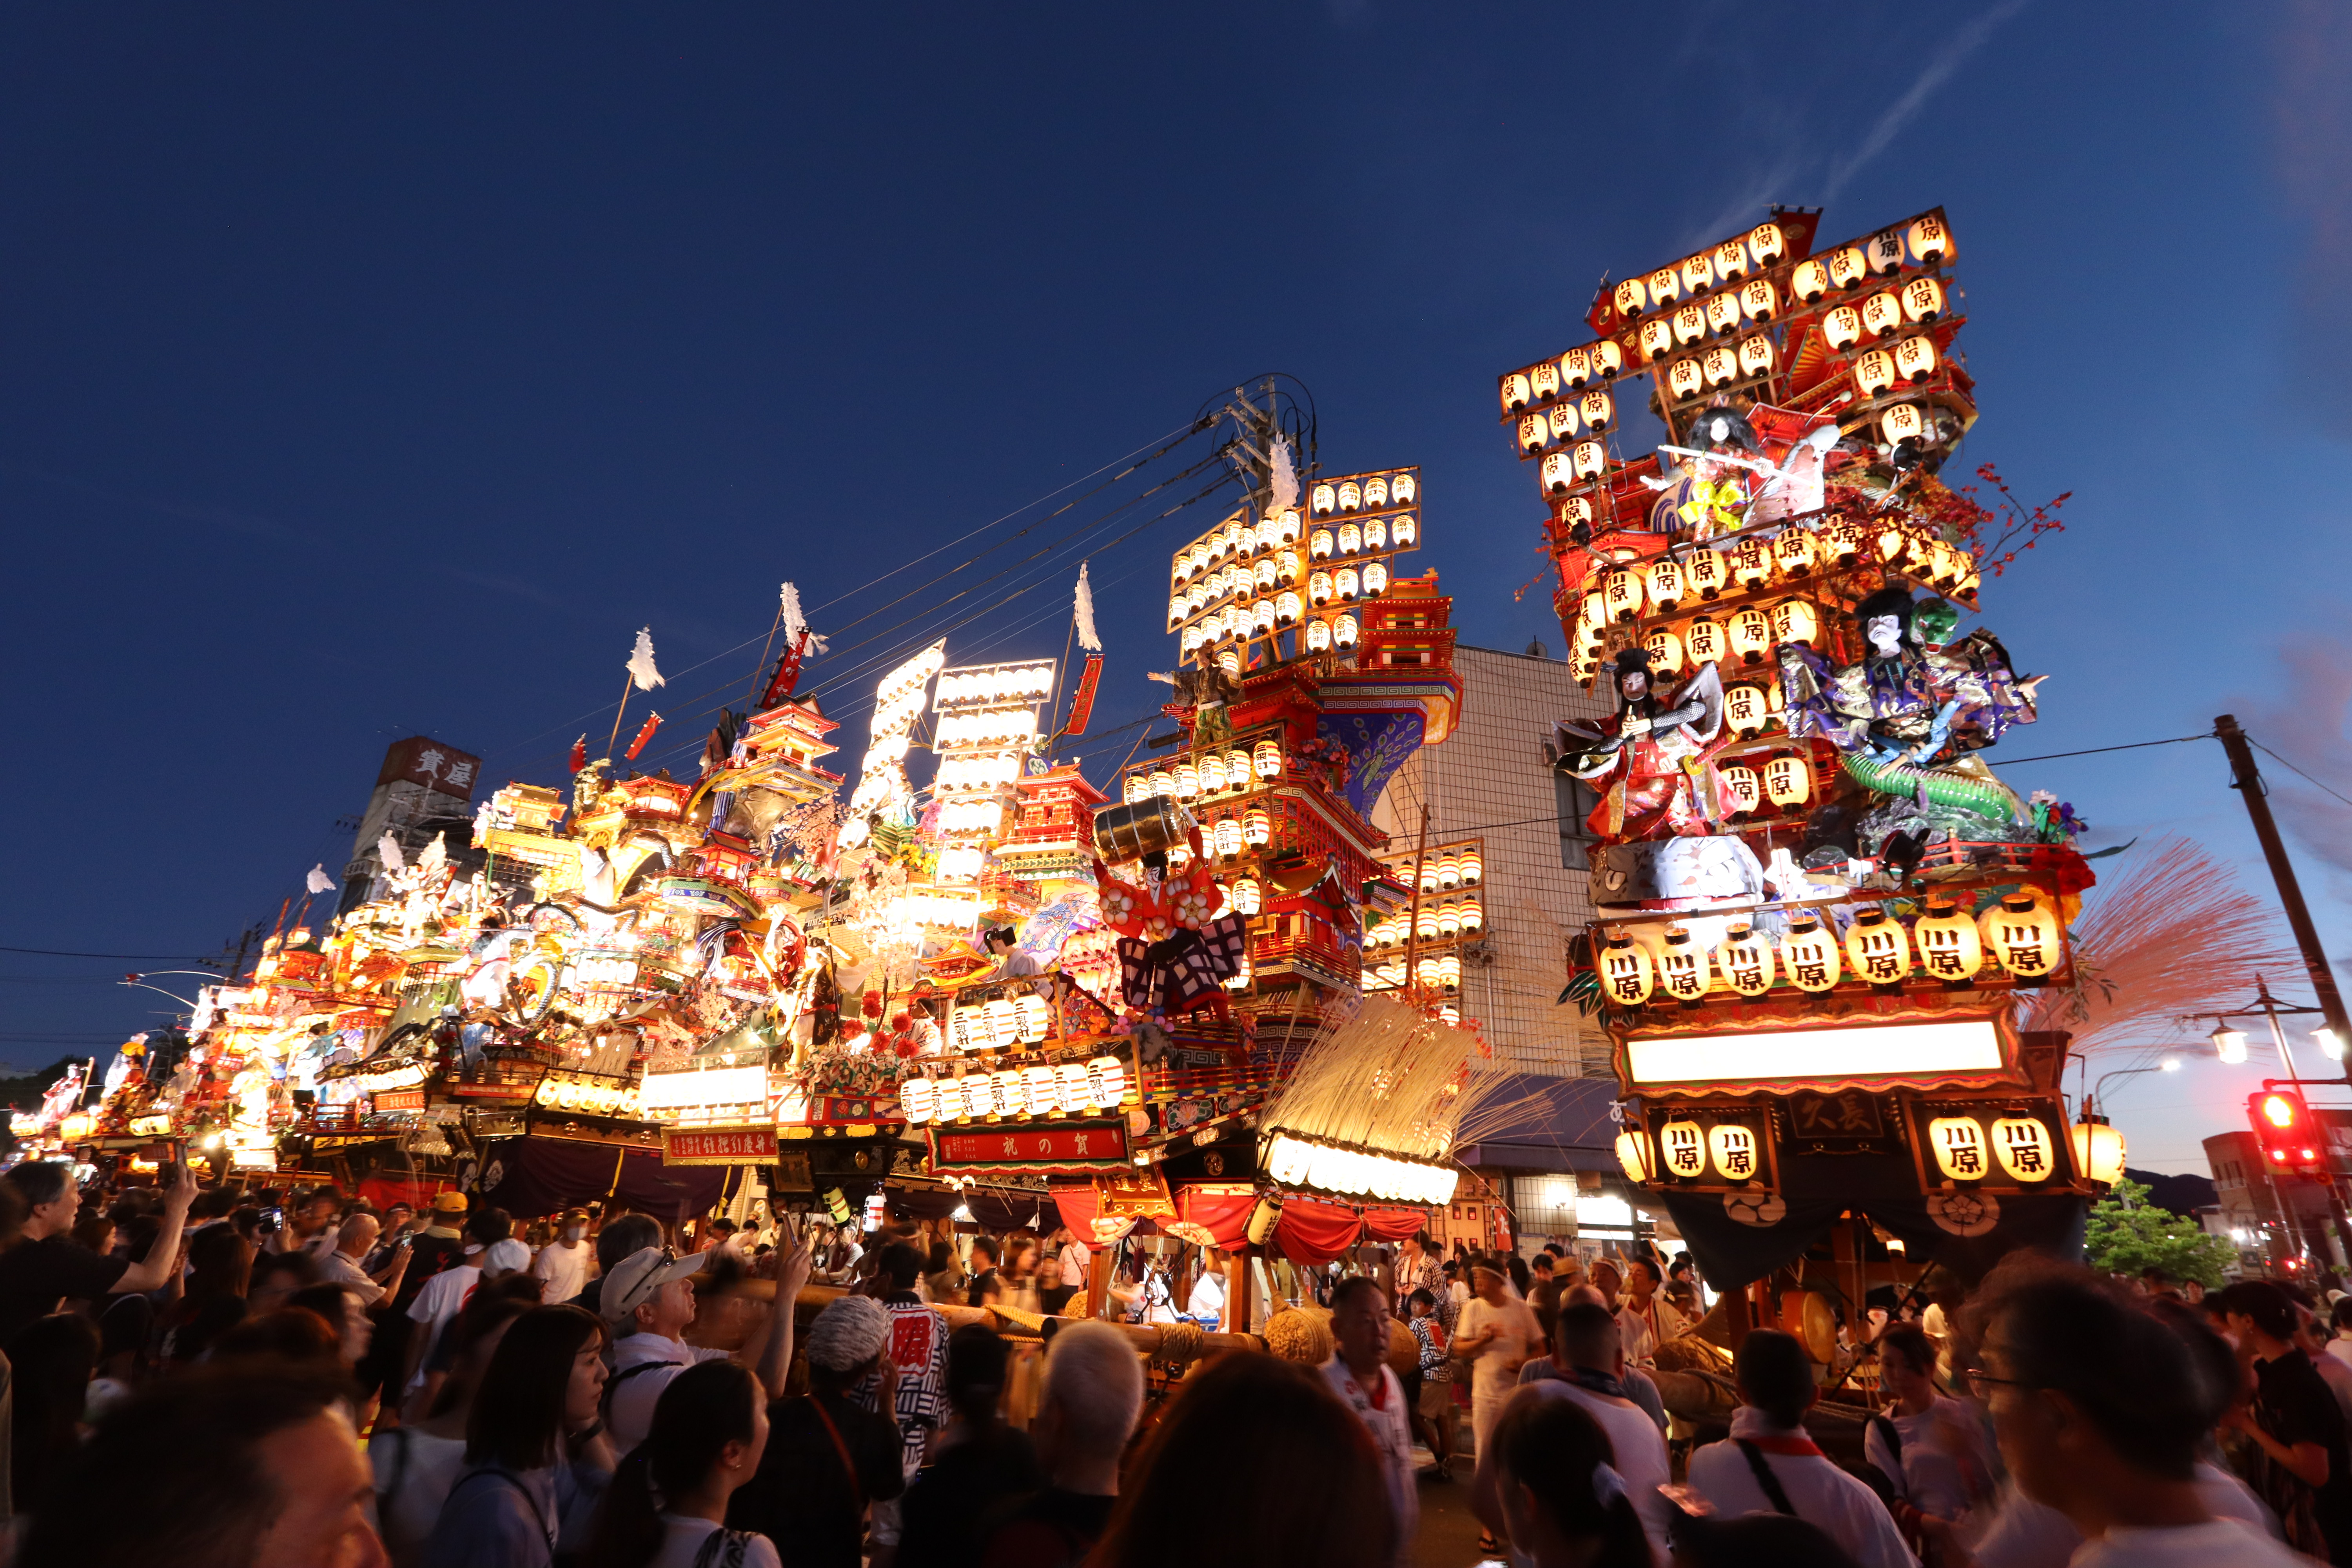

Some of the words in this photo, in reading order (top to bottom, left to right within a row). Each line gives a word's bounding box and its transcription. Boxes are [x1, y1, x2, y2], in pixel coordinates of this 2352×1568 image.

[1755, 225, 1774, 249] 川原
[1920, 218, 1940, 240] 川原
[1722, 242, 1741, 263] 川原
[1879, 232, 1900, 257] 川原
[1690, 256, 1708, 275] 川原
[1832, 248, 1853, 276] 川原
[1618, 281, 1634, 306] 川原
[1654, 269, 1672, 291] 川原
[1748, 281, 1768, 304] 川原
[1910, 280, 1934, 308] 川原
[1681, 307, 1700, 328] 川原
[1710, 295, 1727, 322] 川原
[1836, 309, 1856, 331] 川原
[1865, 296, 1886, 323] 川原
[1643, 321, 1659, 345] 川原
[1569, 350, 1584, 370] 川原
[1592, 343, 1606, 368] 川原
[1747, 337, 1767, 360] 川原
[1901, 339, 1921, 365] 川原
[1537, 364, 1553, 383] 川原
[1674, 361, 1692, 383] 川原
[1706, 350, 1725, 375] 川原
[1862, 351, 1884, 381] 川原
[1504, 376, 1516, 399] 川原
[1553, 404, 1568, 426] 川原
[1587, 392, 1603, 412] 川原
[1522, 415, 1536, 439] 川原
[1892, 406, 1914, 428] 川原
[1545, 455, 1559, 476] 川原
[1577, 444, 1592, 466] 川原
[1566, 499, 1581, 519] 川原
[1780, 528, 1805, 558] 川原
[1655, 564, 1676, 591] 川原
[1691, 550, 1715, 581] 川原
[1609, 574, 1628, 602] 川原
[1743, 612, 1765, 641] 川原
[1777, 606, 1793, 636] 川原
[1647, 635, 1667, 663] 川原
[1691, 624, 1713, 654] 川原
[1730, 690, 1753, 720] 川原
[1200, 759, 1211, 782] 三隈町
[1225, 753, 1235, 777] 三隈町
[1255, 745, 1267, 769] 三隈町
[1125, 779, 1135, 802] 三隈町
[1172, 768, 1183, 792] 三隈町
[1730, 769, 1754, 800] 川原
[1769, 762, 1793, 795] 川原
[1216, 824, 1229, 849] 三隈町
[1243, 813, 1256, 838] 三隈町
[1234, 883, 1246, 910] 三隈町
[1860, 932, 1900, 978] 川原
[1924, 929, 1964, 975] 川原
[2003, 926, 2045, 971] 川原
[1610, 955, 1644, 1000] 川原
[1665, 954, 1700, 995] 川原
[1728, 947, 1766, 991] 川原
[1791, 944, 1829, 986] 川原
[954, 1012, 969, 1045] 三隈町
[983, 1008, 996, 1041] 三隈町
[1014, 1003, 1029, 1037] 三隈町
[541, 1086, 556, 1102] 大和
[960, 1082, 973, 1112] 三隈町
[990, 1077, 1005, 1110] 三隈町
[1020, 1074, 1033, 1109] 三隈町
[1054, 1072, 1069, 1107] 三隈町
[1087, 1065, 1106, 1102] 三隈町
[902, 1087, 913, 1118] 三隈町
[931, 1087, 942, 1116] 三隈町
[1671, 1129, 1699, 1171] 川原
[1724, 1133, 1751, 1173] 川原
[1945, 1126, 1982, 1173] 川原
[2005, 1124, 2045, 1173] 川原
